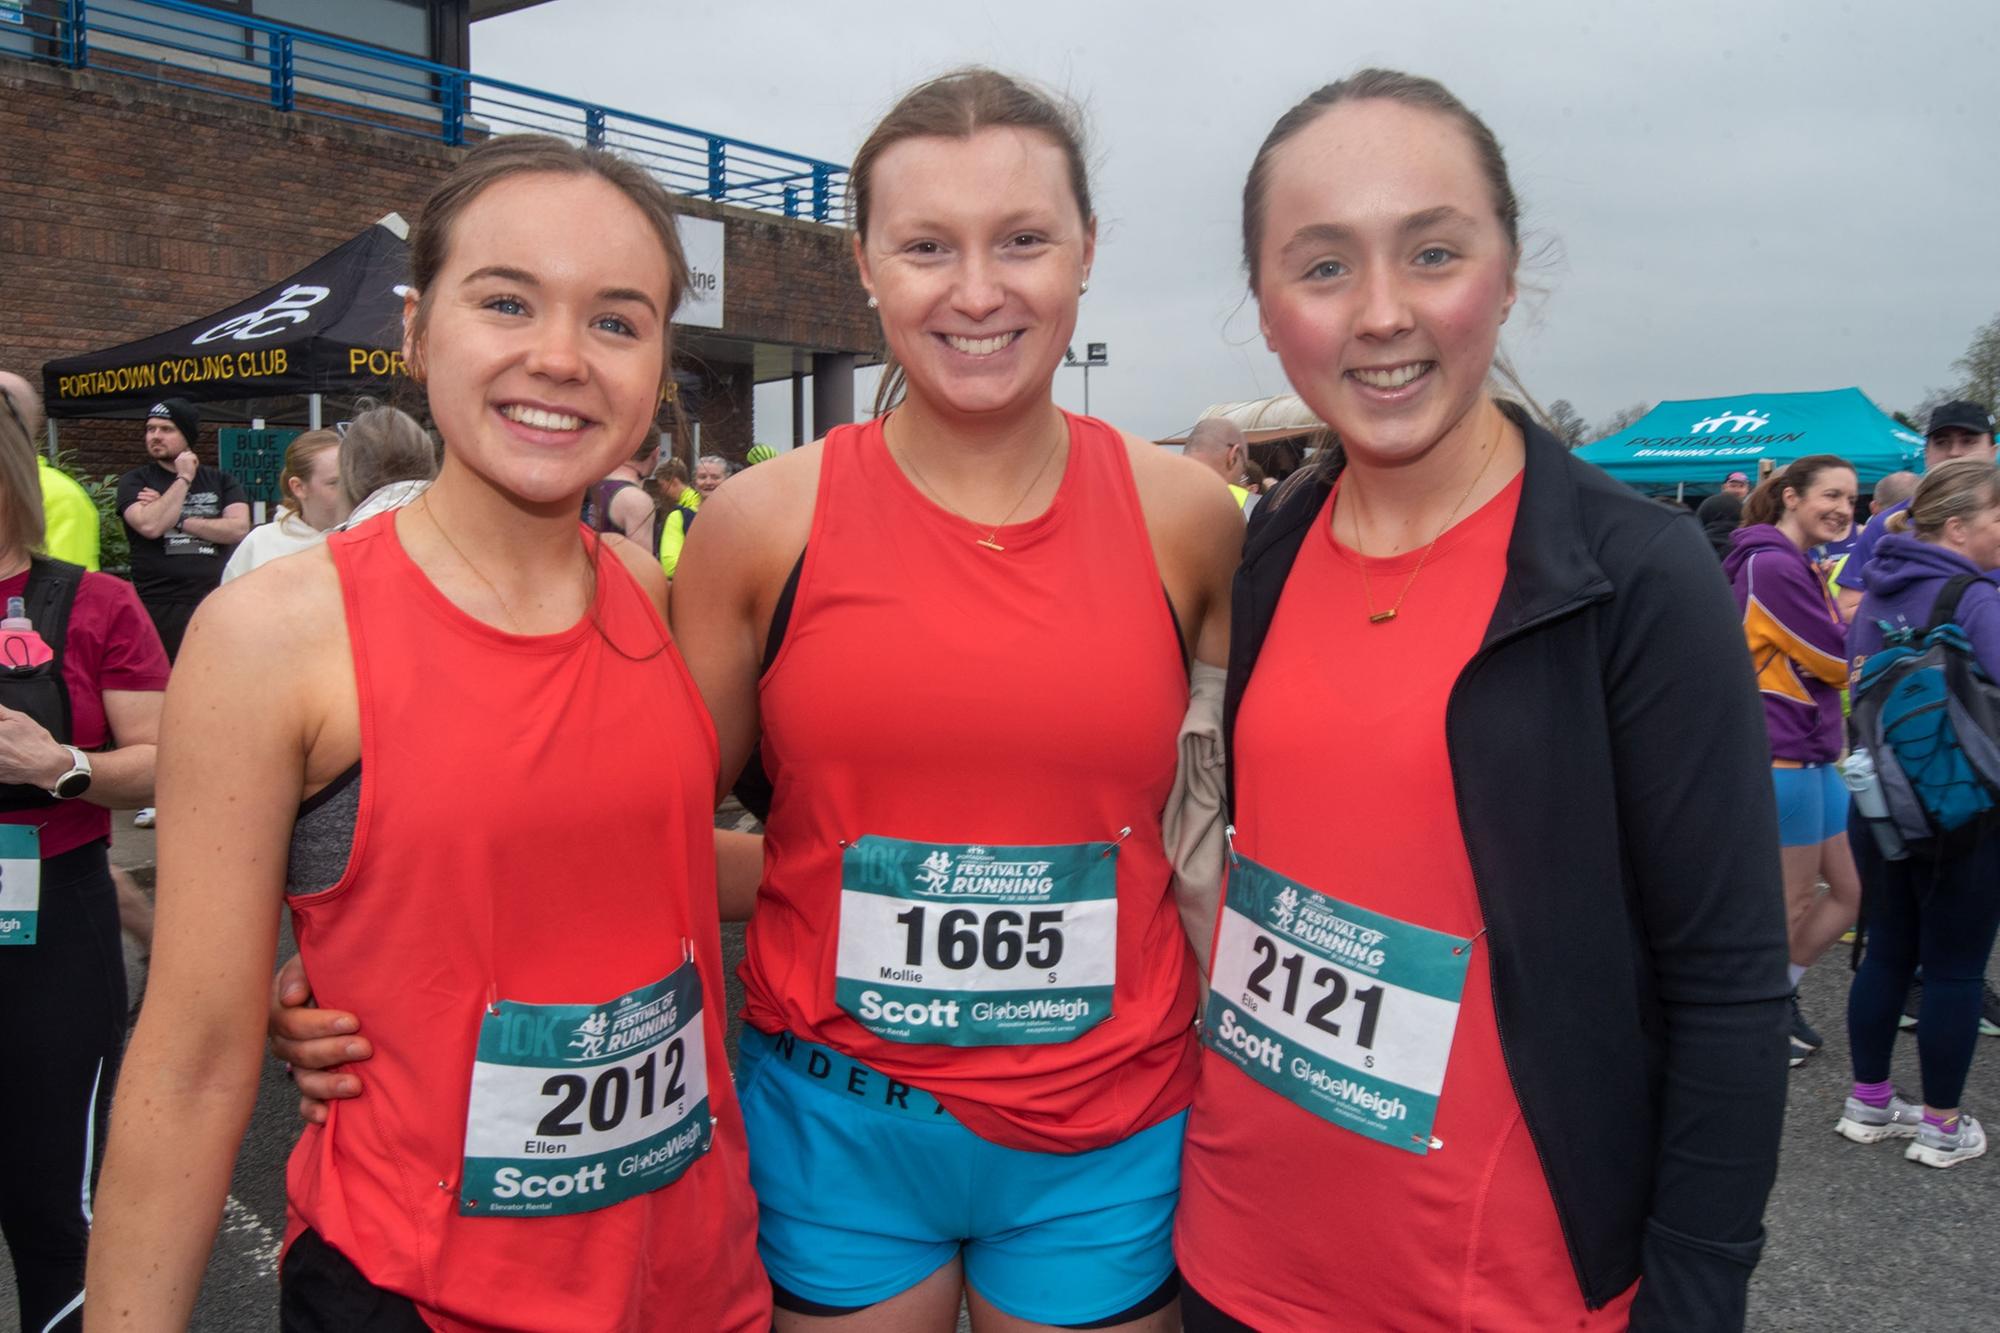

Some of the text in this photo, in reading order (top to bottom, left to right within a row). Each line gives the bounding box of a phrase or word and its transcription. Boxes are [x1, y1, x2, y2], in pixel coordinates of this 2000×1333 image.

[692, 266, 716, 290] ine
[59, 349, 288, 399] PORTADOWN CYCLING CLUB
[350, 348, 409, 376] POR
[237, 434, 279, 450] BLUE
[1624, 431, 1807, 448] PORTADOWN
[1632, 446, 1766, 458] RUNNING CLUB
[232, 451, 281, 470] BADGE
[951, 877, 1054, 895] RUNNING
[955, 863, 1049, 877] FESTIVAL OF
[897, 906, 1064, 971] 1665
[1294, 919, 1385, 966] RUNNING
[1299, 907, 1384, 947] FESTIVAL OF
[880, 966, 923, 983] Mollie
[1048, 972, 1057, 983] S
[1246, 935, 1385, 1050] 2121
[612, 1003, 660, 1033] FESTIVAL
[661, 993, 675, 1009] OF
[858, 990, 960, 1028] Scott
[500, 1012, 563, 1058] 10K
[606, 1006, 677, 1052] RUNNING
[1218, 1009, 1283, 1073] Scott
[775, 1032, 945, 1115] NDER
[1364, 1055, 1375, 1068] S
[536, 1037, 685, 1136] 2012
[524, 1140, 567, 1154] Ellen
[492, 1162, 607, 1198] Scott
[490, 1202, 552, 1211] Elevator Rental
